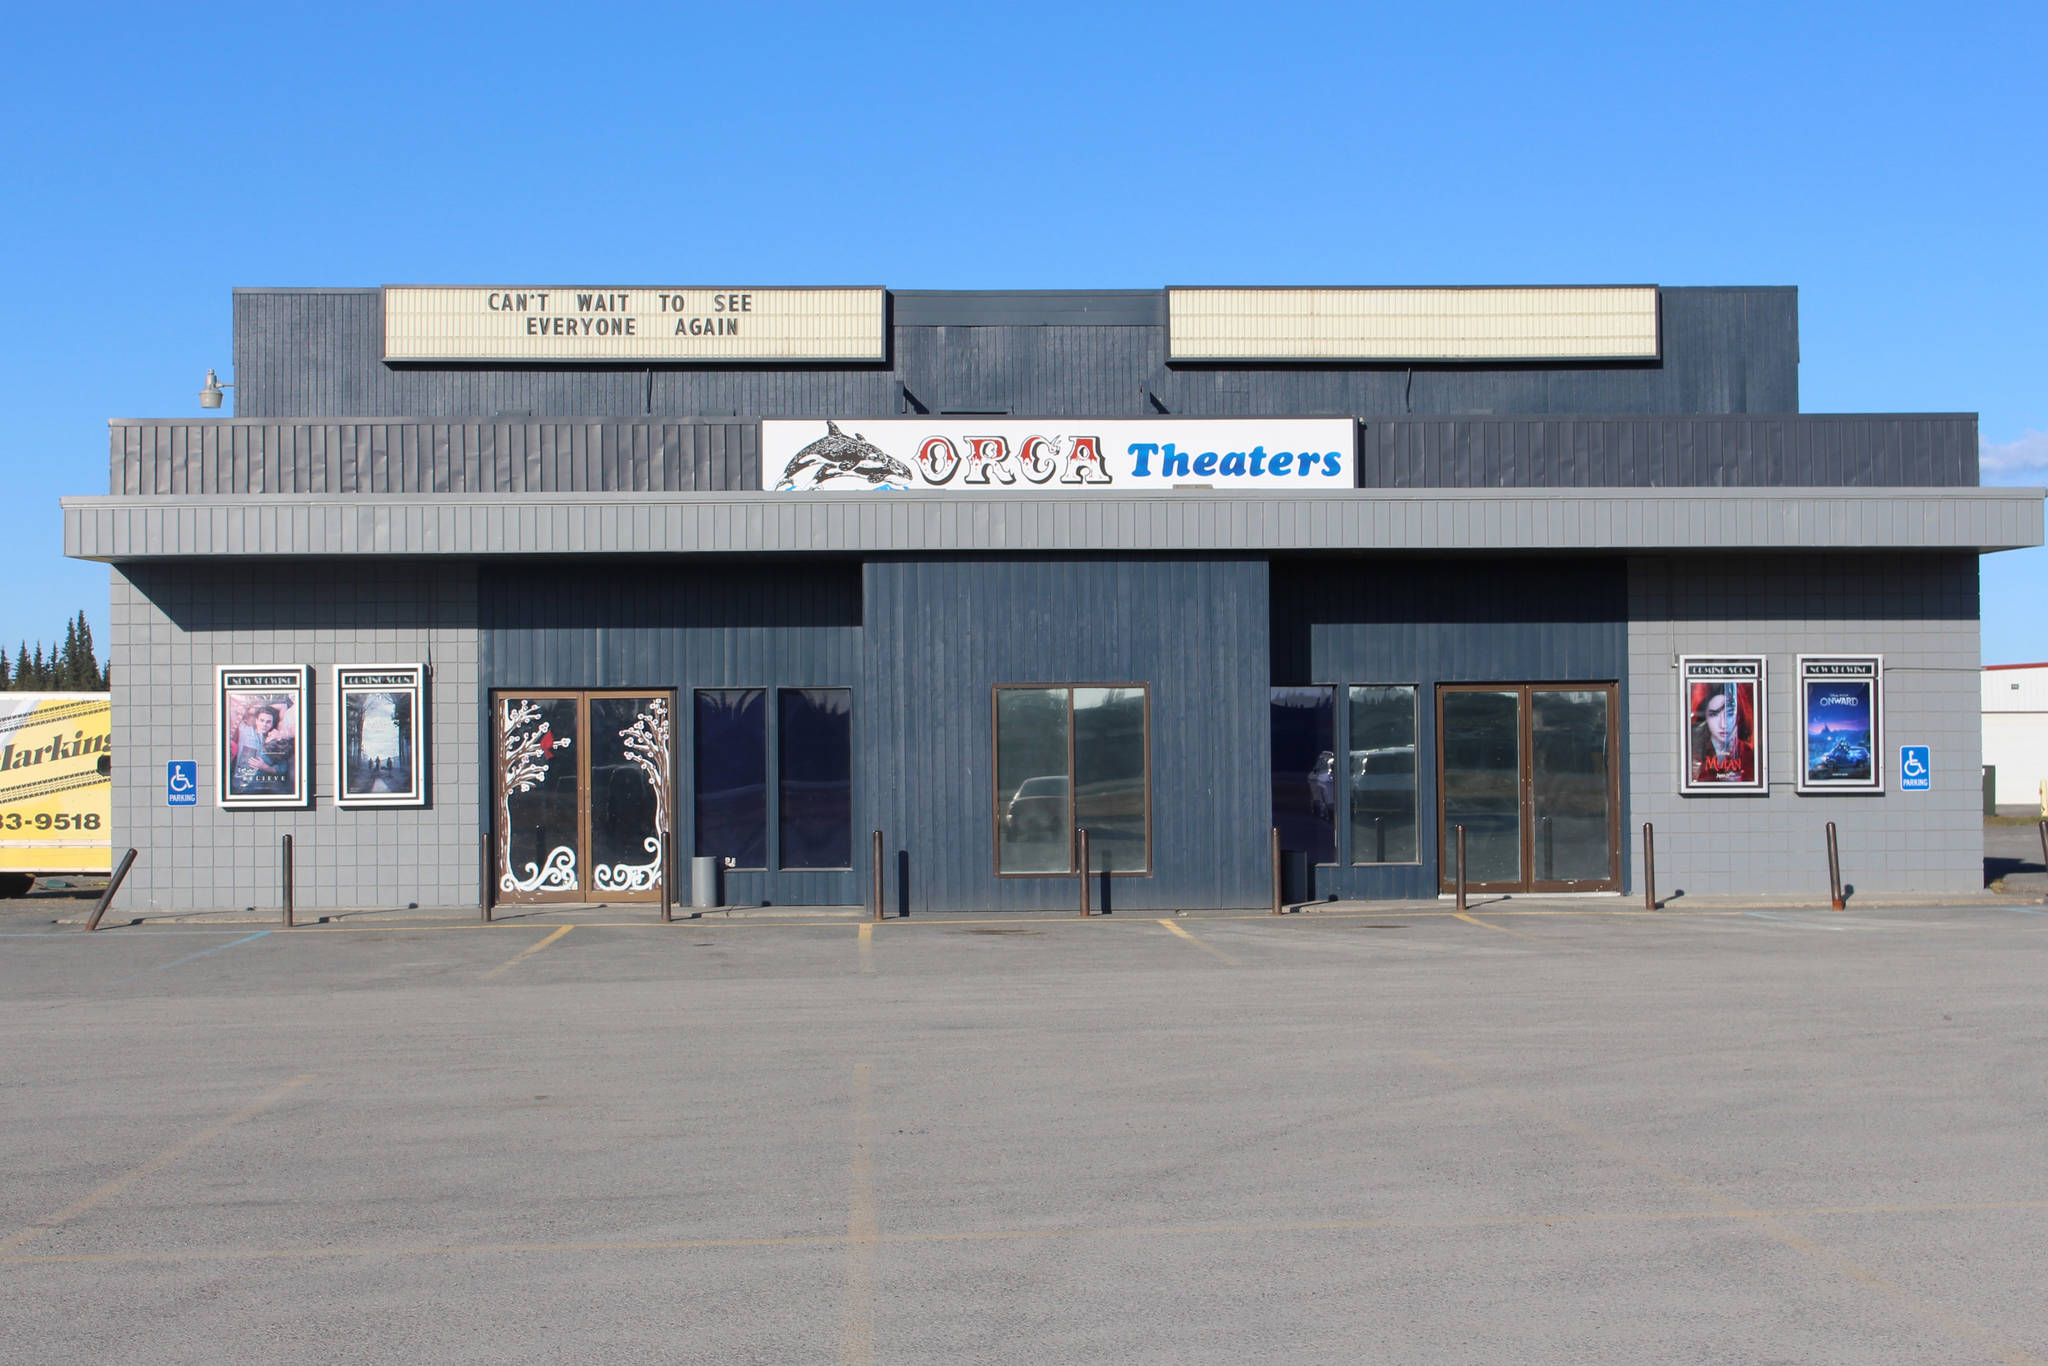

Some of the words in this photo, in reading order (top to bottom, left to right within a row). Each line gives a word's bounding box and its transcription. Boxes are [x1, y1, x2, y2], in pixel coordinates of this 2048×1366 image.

[488, 293, 549, 311] CAN'T
[577, 294, 629, 312] WAIT
[659, 294, 685, 312] TO
[714, 294, 752, 312] SEE
[526, 317, 636, 335] EVERYONE
[675, 318, 738, 336] AGAIN
[912, 435, 1112, 485] ORCA
[1127, 443, 1342, 477] Theaters
[1820, 697, 1859, 706] ONWARD
[1705, 754, 1742, 771] MULAN
[1903, 778, 1929, 787] PARKING
[169, 794, 196, 802] PARKING
[0, 813, 101, 830] 3-9518
